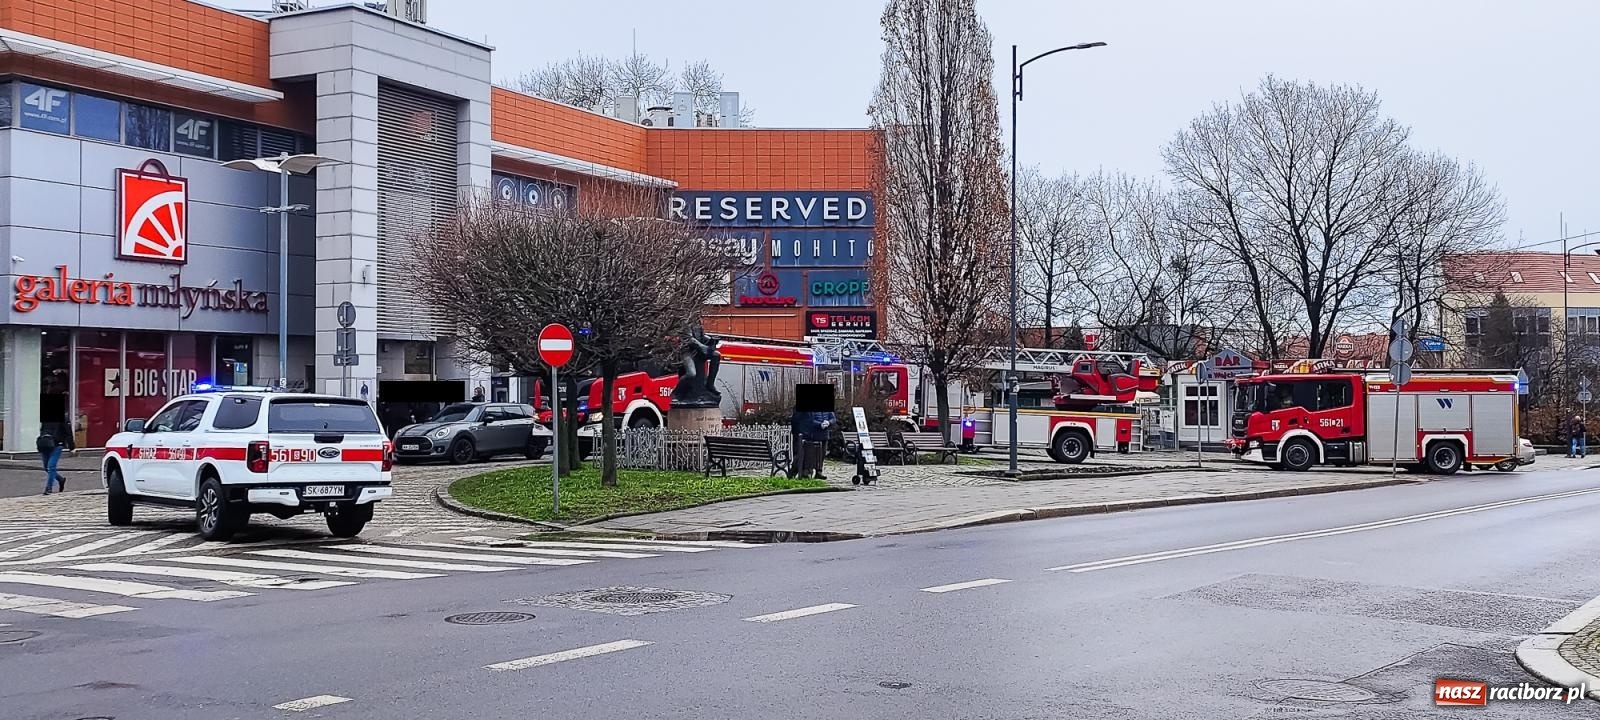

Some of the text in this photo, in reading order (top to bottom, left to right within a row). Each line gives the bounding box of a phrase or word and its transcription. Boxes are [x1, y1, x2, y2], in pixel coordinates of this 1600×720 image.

[24, 87, 66, 113] 4F
[176, 118, 211, 141] 4F
[669, 197, 867, 220] RESERVED
[772, 239, 874, 257] MOHITO
[13, 265, 269, 320] galeria młyńska
[1215, 354, 1241, 366] BAR
[134, 369, 158, 396] BIG
[307, 487, 318, 495] SK
